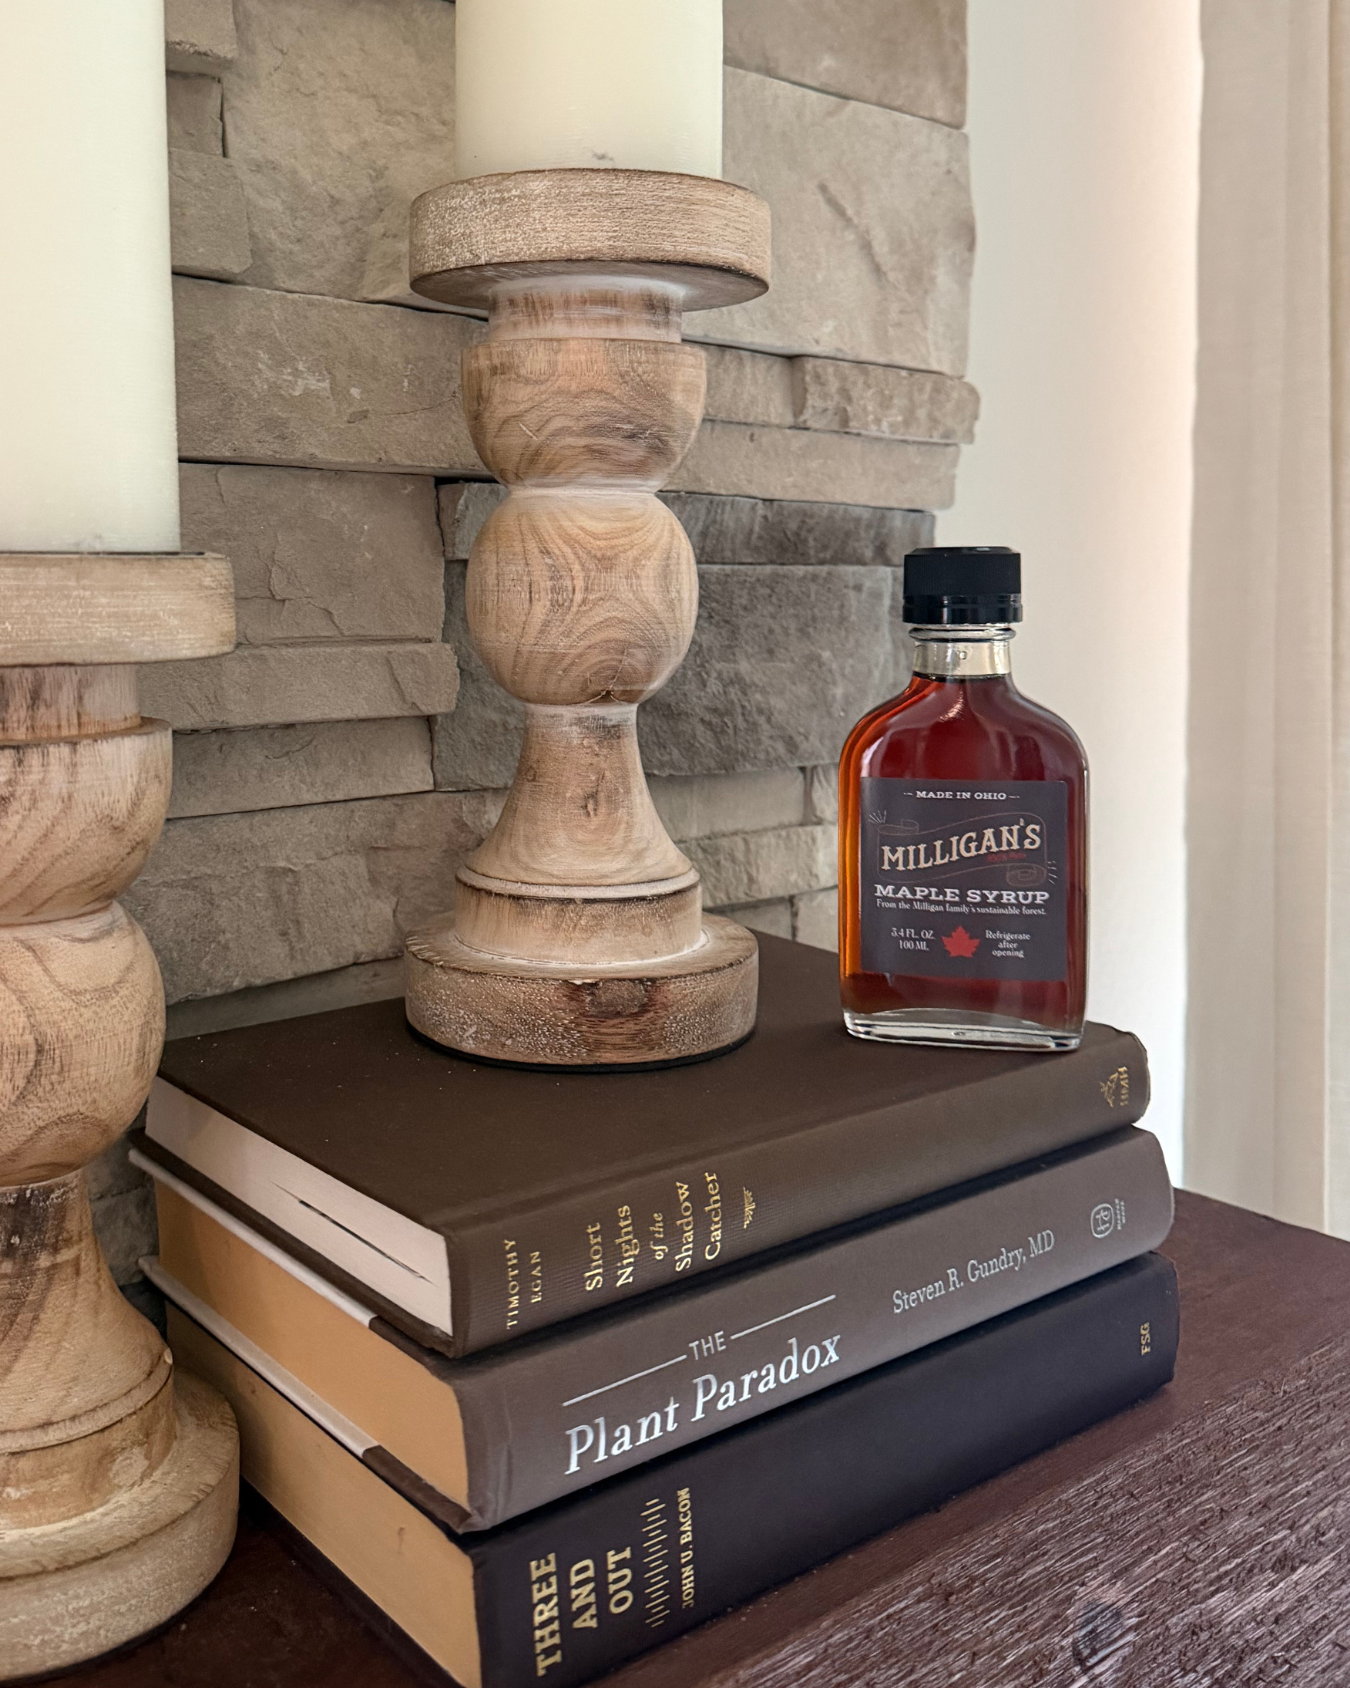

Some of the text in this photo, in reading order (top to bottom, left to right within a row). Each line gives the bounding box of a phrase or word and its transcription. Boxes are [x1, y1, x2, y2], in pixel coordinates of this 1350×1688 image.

[916, 790, 1007, 800] MADE IN OHIO
[881, 817, 1041, 871] MILLIGAN'S
[874, 884, 1050, 904] MAPLE SYRUP
[876, 898, 897, 909] From
[898, 900, 911, 910] the
[912, 901, 945, 913] Milligan
[945, 903, 976, 915] family's
[976, 905, 1020, 915] sustainable
[891, 927, 904, 938] 3.4
[899, 939, 915, 950] 100
[985, 929, 1031, 941] Refrigerate
[991, 949, 1025, 959] opening
[997, 940, 1018, 949] after
[650, 1211, 668, 1261] of the
[674, 1181, 693, 1272] Shadow
[704, 1171, 722, 1261] Catcher
[585, 1222, 603, 1291] Short
[615, 1205, 640, 1288] Nights
[892, 1229, 1055, 1314] Steven R. Gundry, MD
[504, 1238, 519, 1330] TIMOTHY
[529, 1251, 542, 1304] EGAN
[688, 1330, 728, 1361] THE
[1139, 1321, 1151, 1356] FSG
[564, 1334, 842, 1475] Plant Paradox
[676, 1487, 695, 1609] JOHN U. BACON
[569, 1558, 598, 1629] AND
[606, 1546, 635, 1614] OUT
[529, 1552, 562, 1677] THREE
